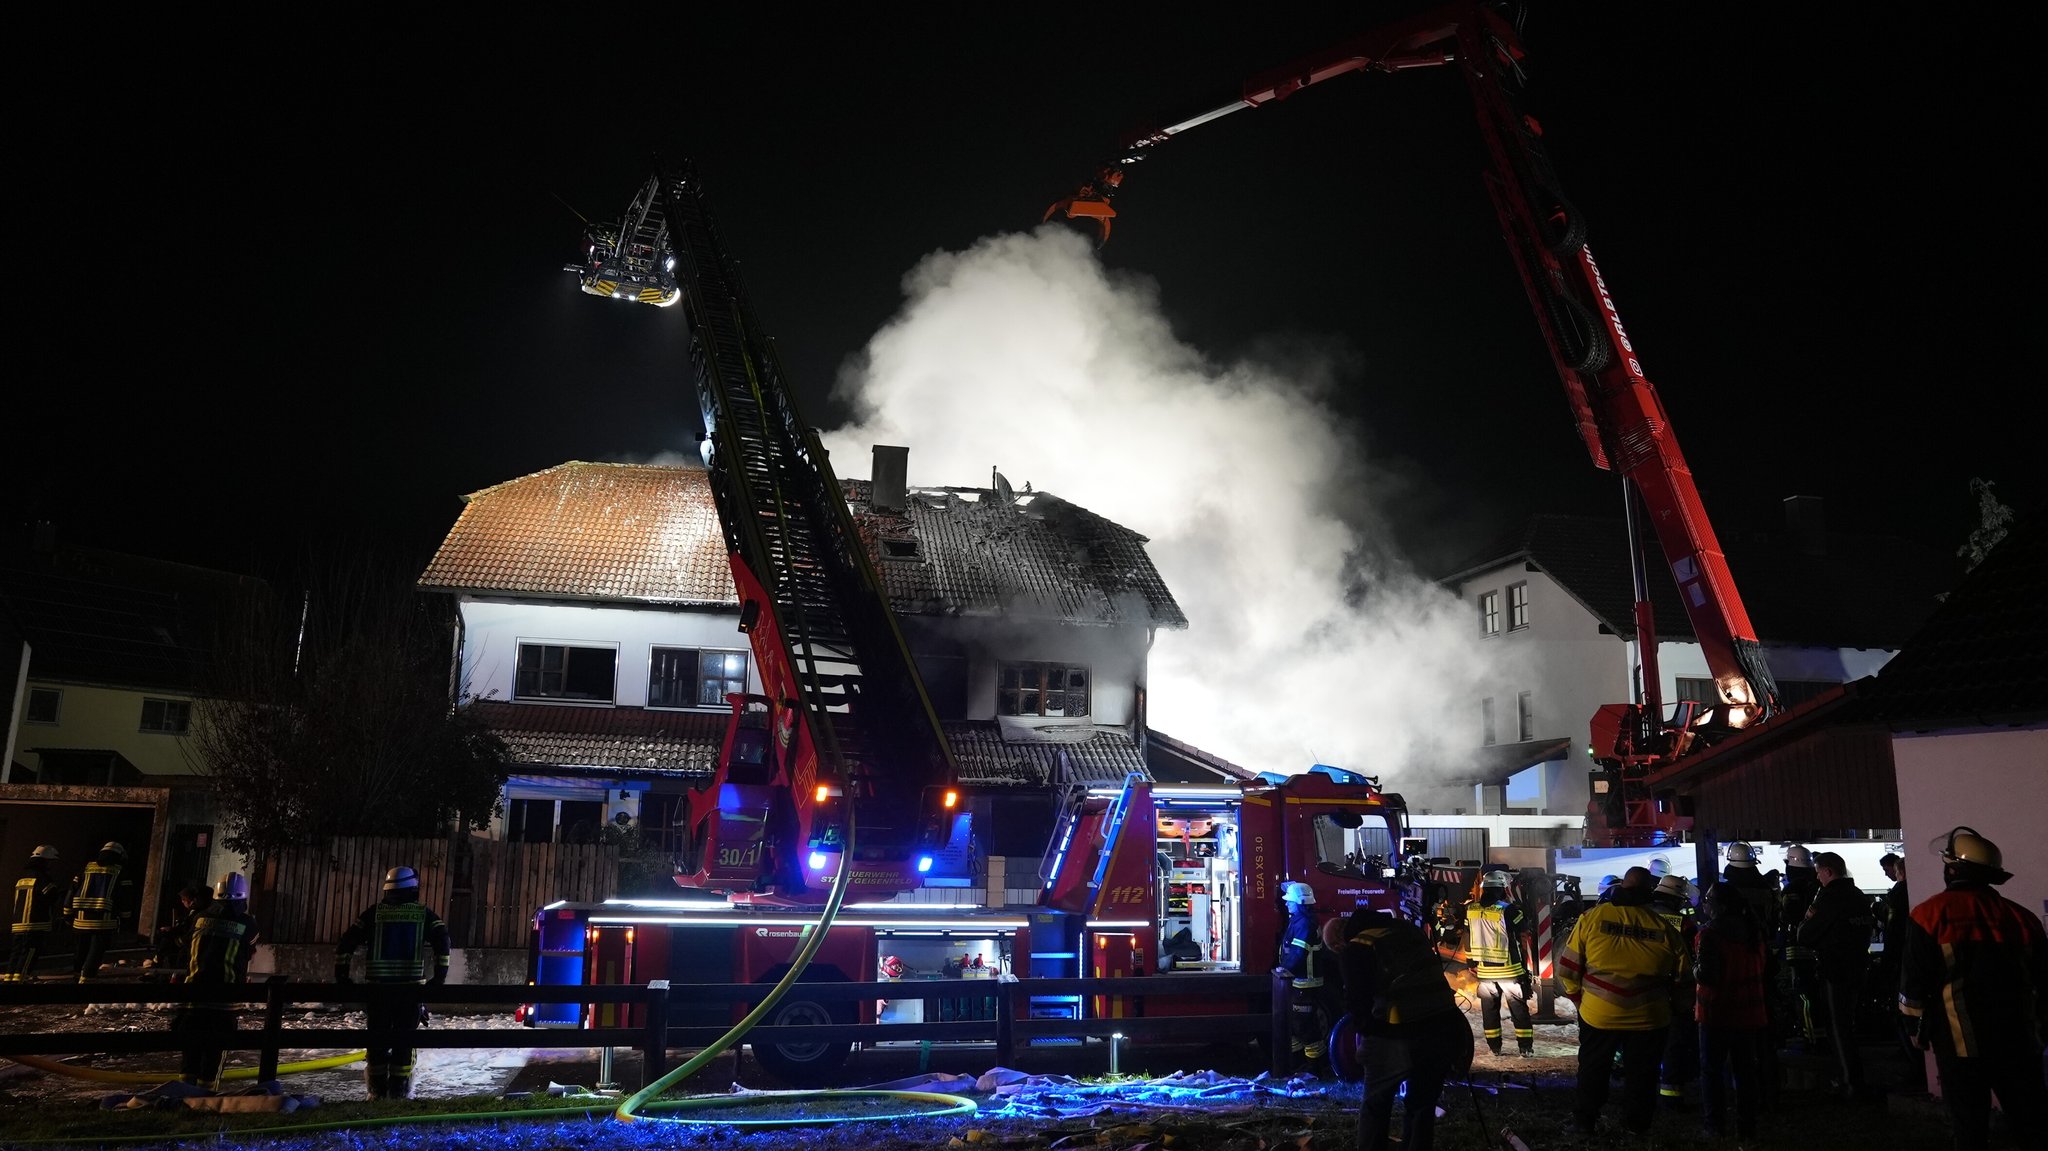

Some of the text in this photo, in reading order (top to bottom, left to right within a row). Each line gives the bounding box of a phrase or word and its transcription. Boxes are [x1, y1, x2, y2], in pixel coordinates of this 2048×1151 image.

[719, 848, 755, 867] 30/1
[1254, 836, 1265, 899] L32A XS 3.0
[820, 876, 913, 885] STAT GEISENFELD
[1111, 886, 1144, 904] 112
